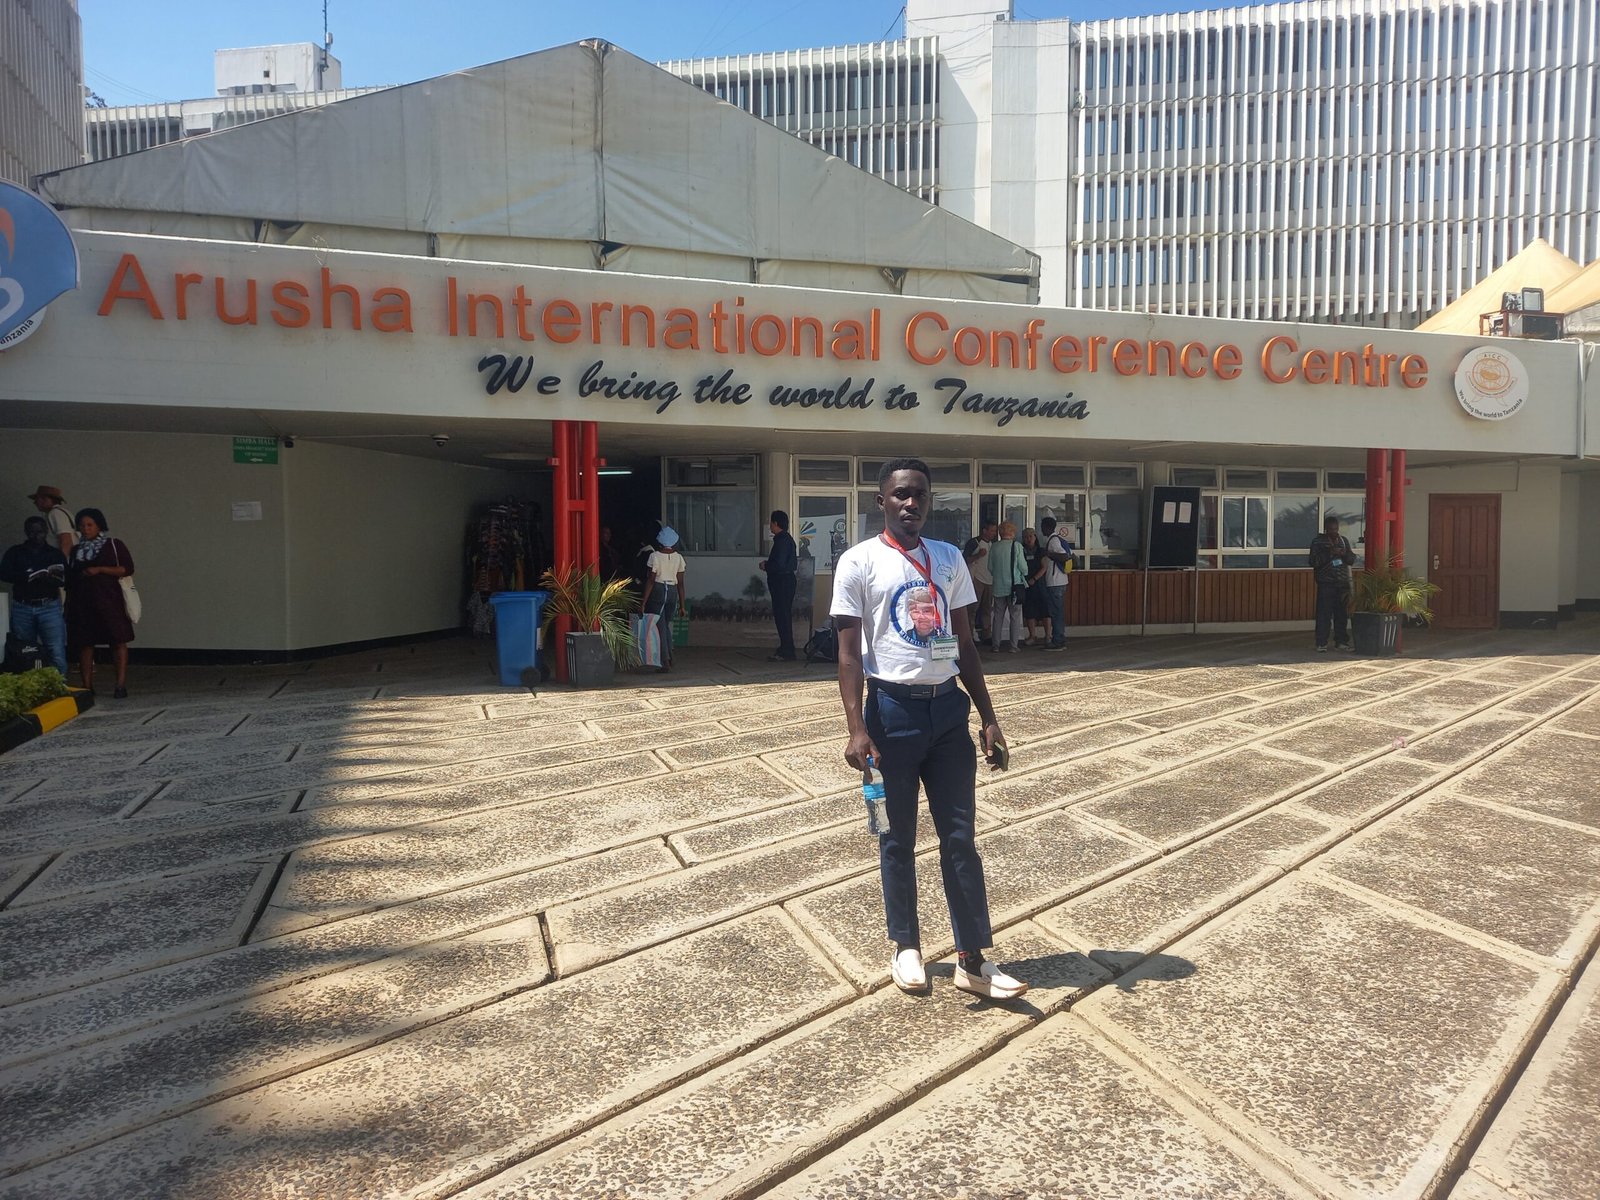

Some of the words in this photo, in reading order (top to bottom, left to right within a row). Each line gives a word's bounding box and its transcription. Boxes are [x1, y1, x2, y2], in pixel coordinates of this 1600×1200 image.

[97, 253, 414, 333] Arusha
[447, 276, 881, 361] International
[905, 311, 1243, 380] Conference
[1261, 335, 1429, 388] Centre
[477, 354, 561, 396] We
[578, 360, 682, 414] bring
[692, 368, 752, 406] the
[769, 377, 876, 410] world
[884, 383, 920, 411] to
[934, 377, 1090, 427] Tanzania
[1463, 398, 1475, 412] bring
[1474, 408, 1482, 416] the
[1503, 399, 1523, 415] Tanzania
